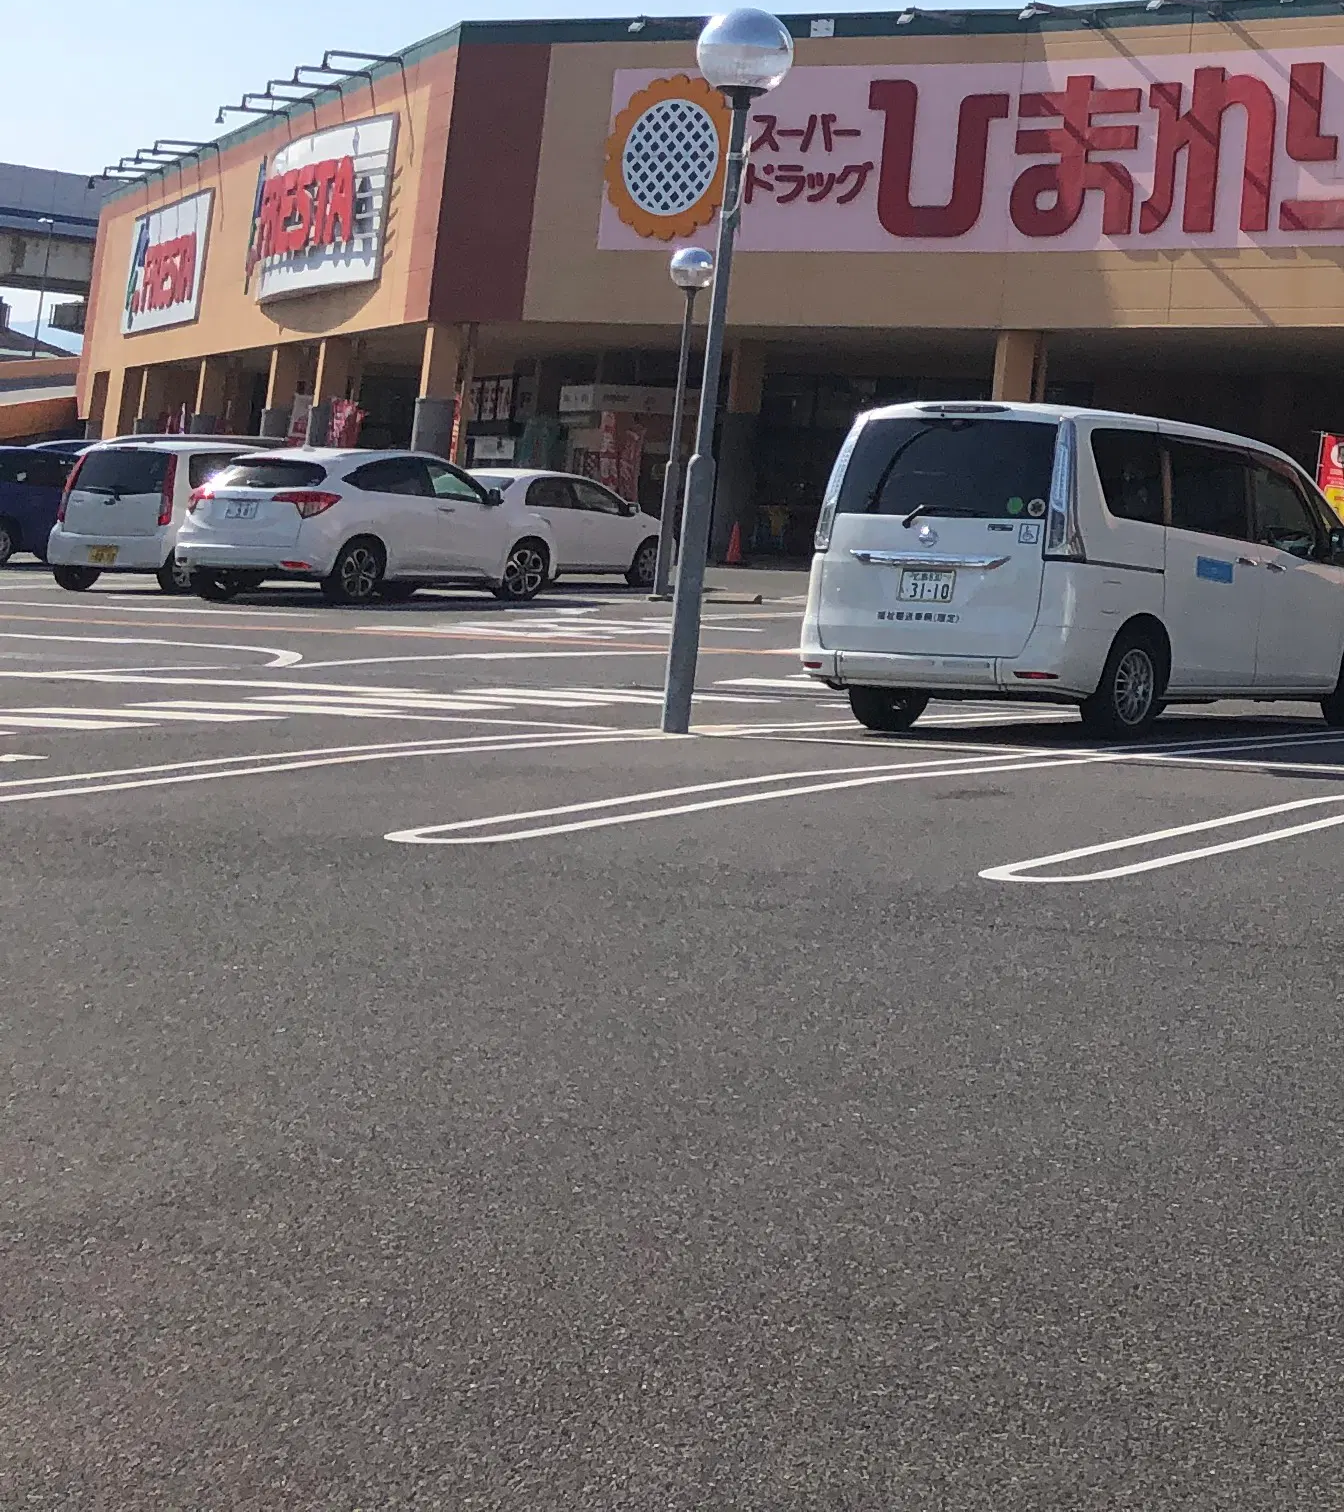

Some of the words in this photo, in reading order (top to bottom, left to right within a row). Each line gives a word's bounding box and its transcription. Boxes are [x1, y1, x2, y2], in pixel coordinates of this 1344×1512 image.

[750, 113, 861, 153] スーパー
[744, 161, 874, 204] ドラッグ
